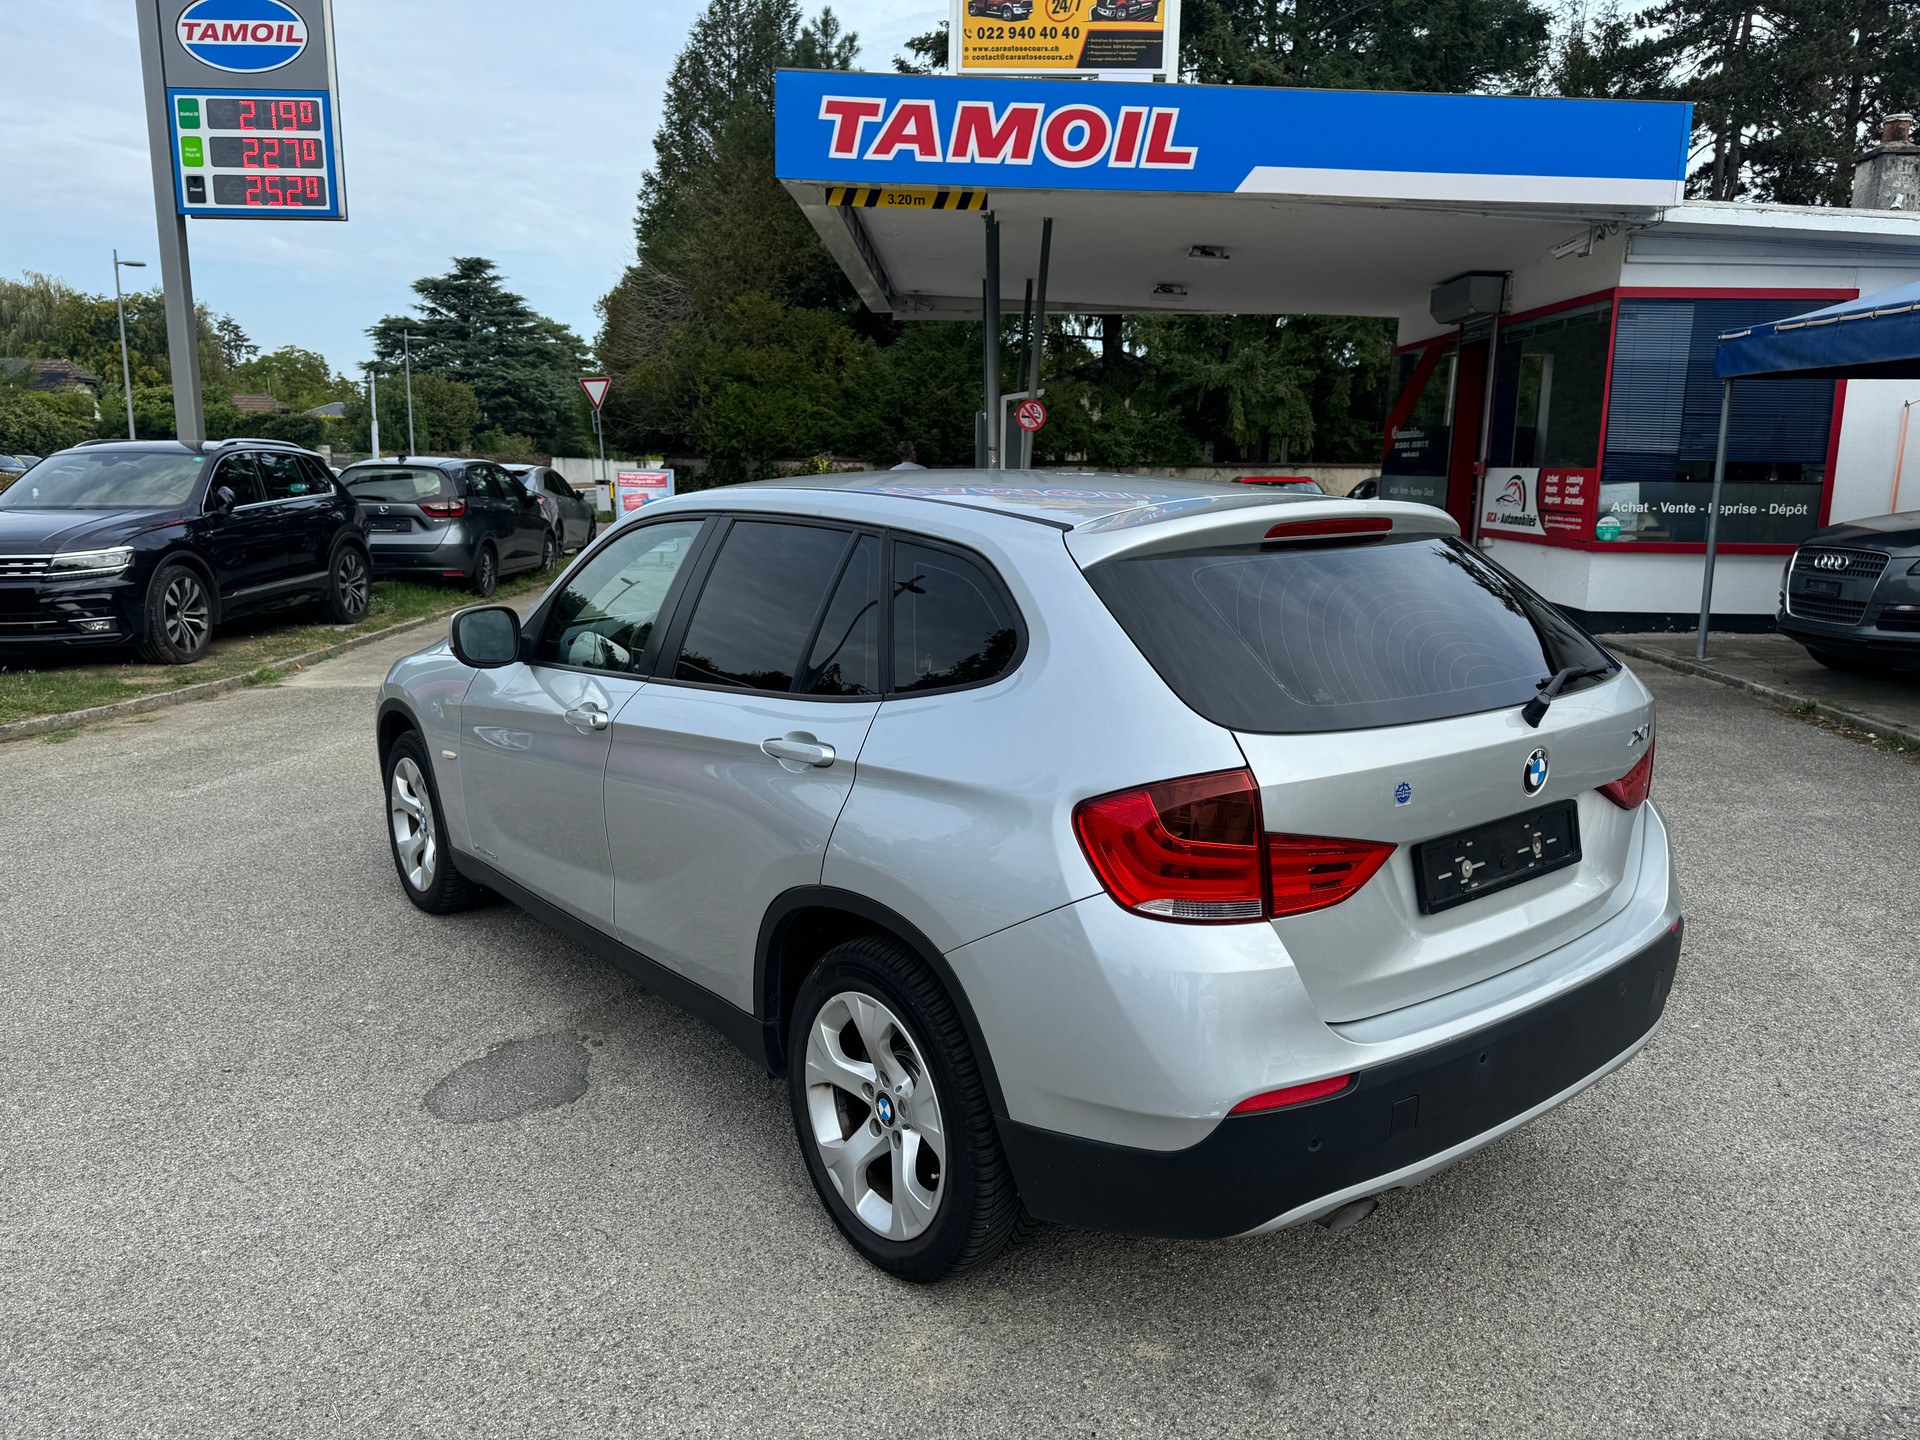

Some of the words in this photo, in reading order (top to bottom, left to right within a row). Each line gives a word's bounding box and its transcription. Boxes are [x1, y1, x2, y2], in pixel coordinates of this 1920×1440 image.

[181, 22, 304, 43] TAMOIL
[977, 26, 1004, 40] 022
[1008, 26, 1036, 40] 940
[1039, 26, 1058, 40] 40
[1061, 26, 1080, 40] 40
[971, 53, 1074, 61] contact@carautosecours.ch
[818, 95, 1199, 170] TAMOIL
[887, 193, 912, 205] 3.20
[913, 197, 925, 206] m
[1546, 474, 1559, 483] Achat
[1565, 474, 1584, 485] Leasing
[1611, 502, 1649, 513] Achat
[1660, 502, 1696, 514] Vente
[1708, 502, 1757, 517] eprise
[1769, 503, 1808, 517] Dépôt
[1500, 512, 1537, 528] Automobiles
[1626, 723, 1651, 748] X1
